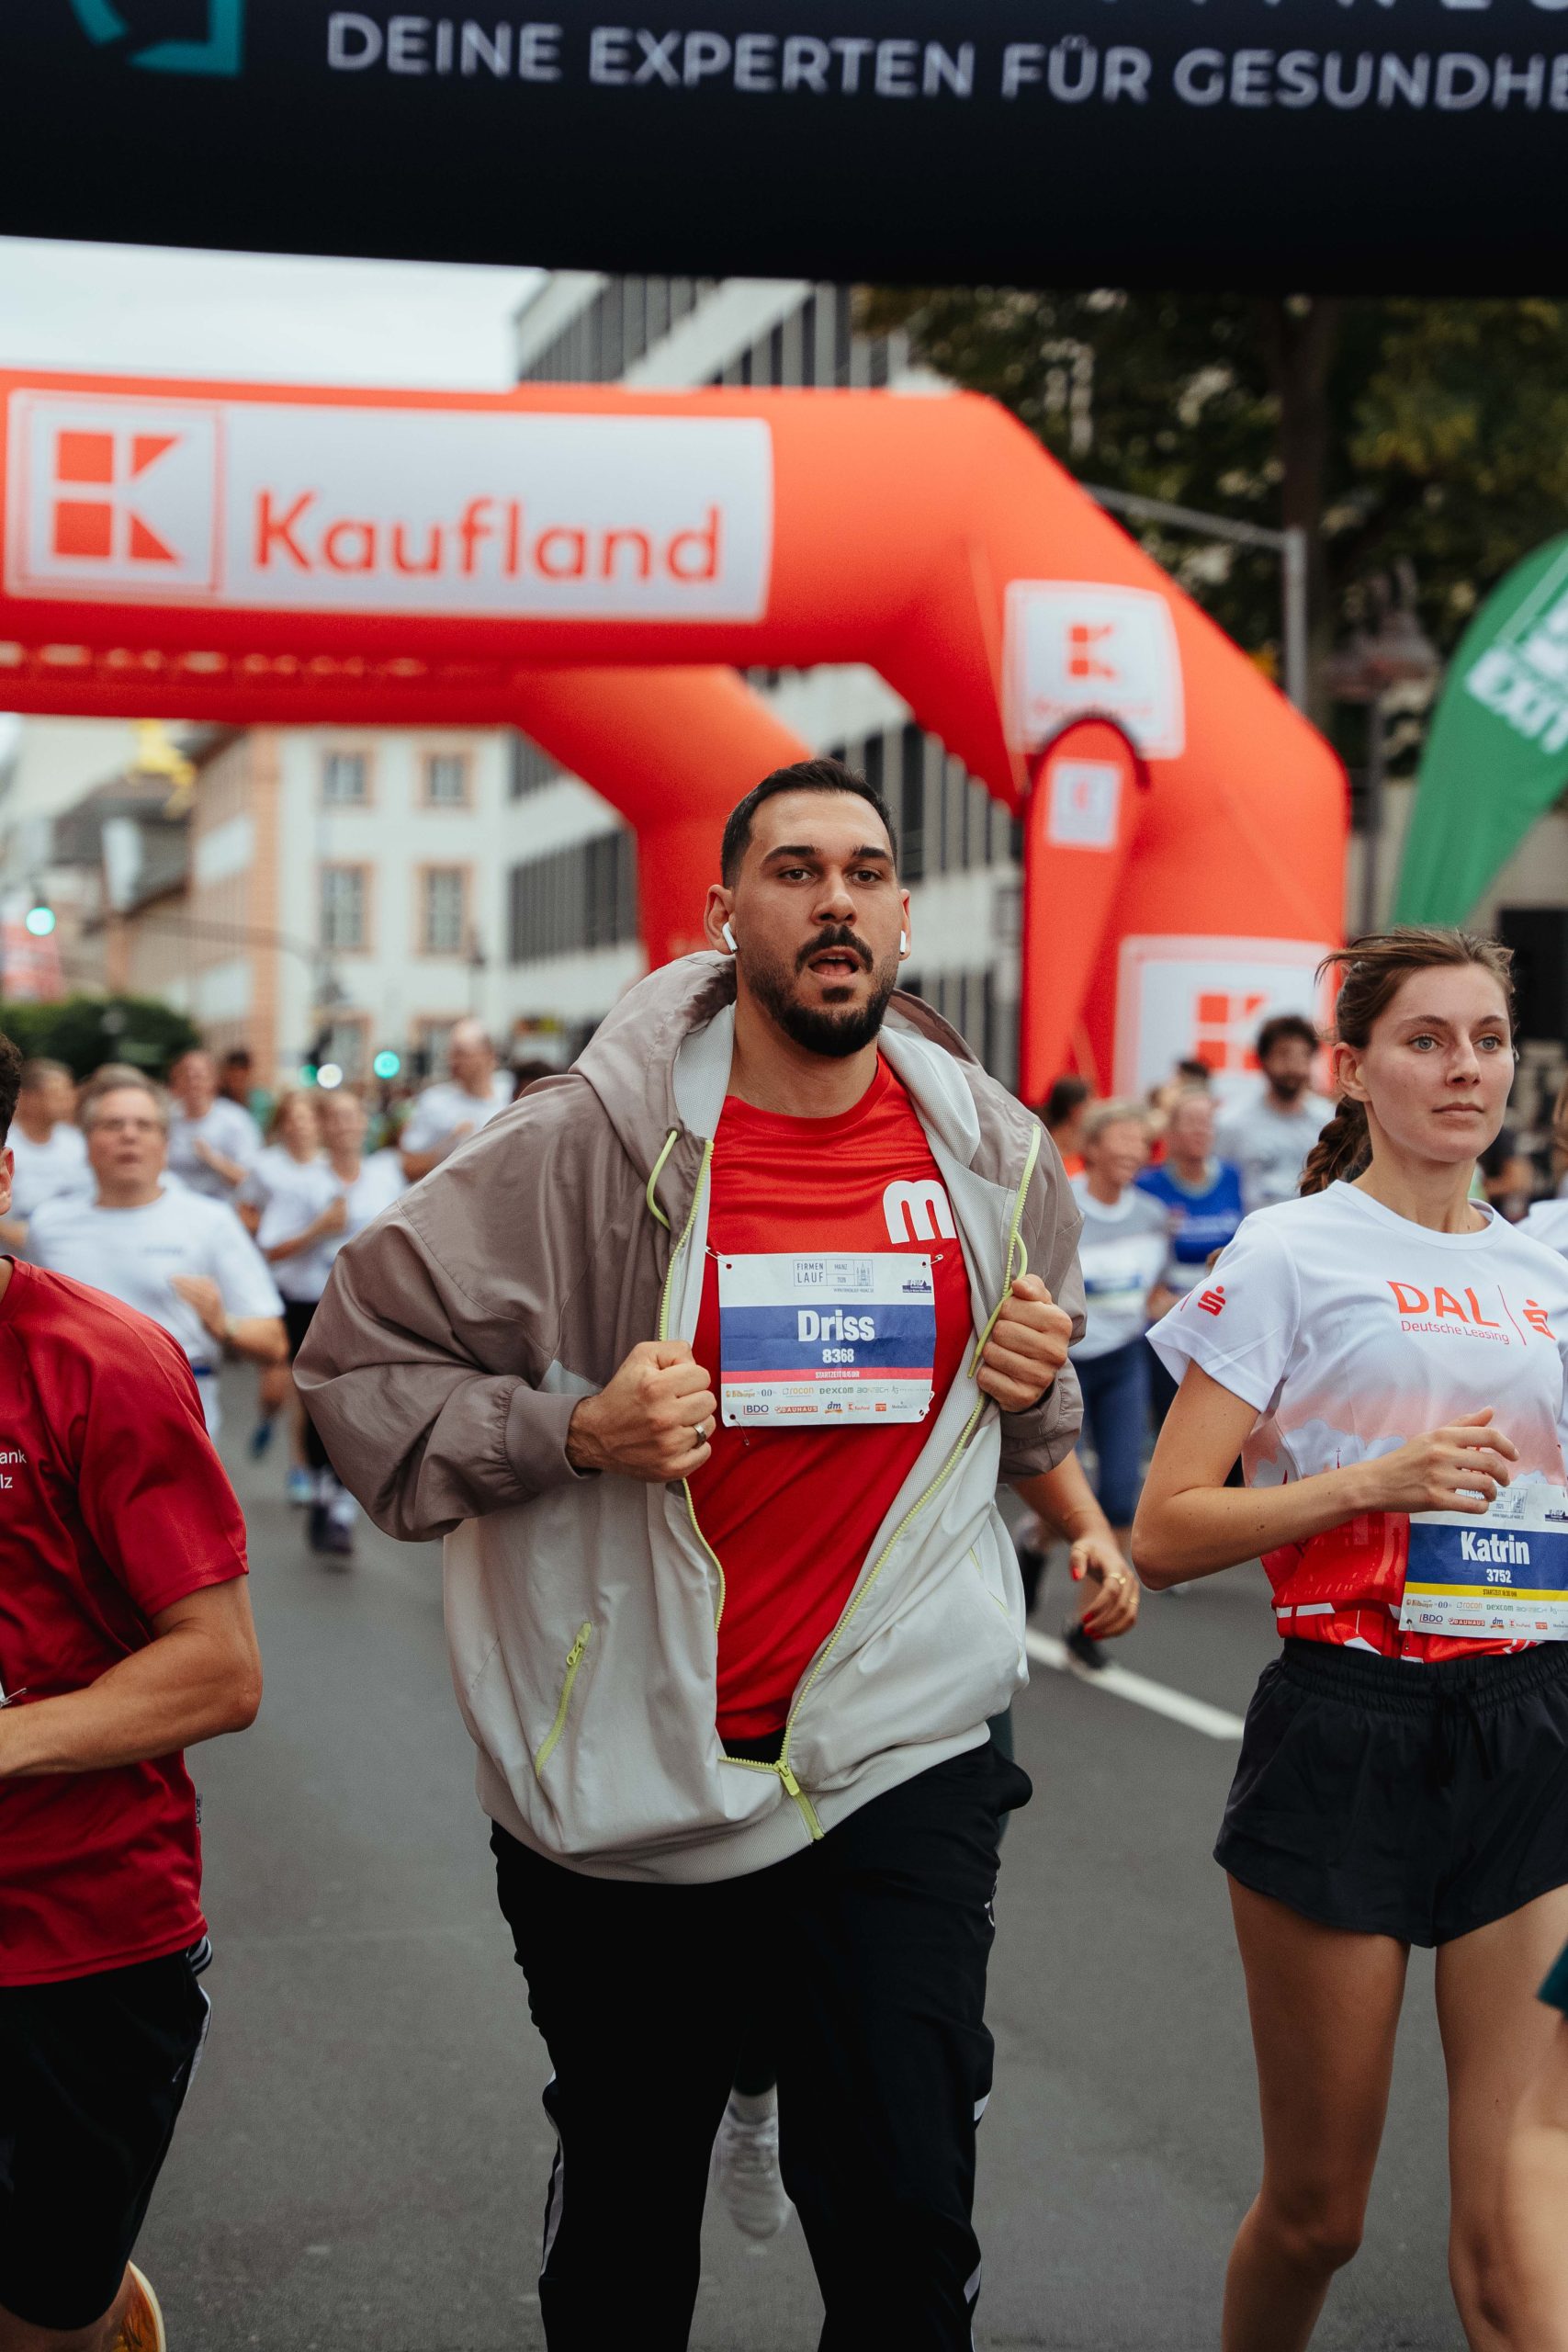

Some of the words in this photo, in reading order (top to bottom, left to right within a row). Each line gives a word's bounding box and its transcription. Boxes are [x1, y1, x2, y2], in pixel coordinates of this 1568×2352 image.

[327, 12, 562, 81] DEINE
[589, 26, 976, 98] EXPERTEN
[1001, 35, 1152, 103] FÜR
[255, 487, 722, 584] Kaufland
[796, 1262, 824, 1271] FIRMEN
[797, 1272, 824, 1283] LAUF
[1386, 1281, 1501, 1328] DAL
[797, 1309, 875, 1341] Driss
[1401, 1320, 1462, 1335] Deutsche
[1464, 1326, 1510, 1345] Leasing
[822, 1348, 854, 1363] 8368
[747, 1405, 769, 1413] BDO
[828, 1401, 841, 1409] dm
[1461, 1531, 1530, 1565] Katrin
[1486, 1568, 1512, 1583] 3752
[1422, 1613, 1443, 1623] BDO
[1454, 1618, 1485, 1626] BAUHAUS
